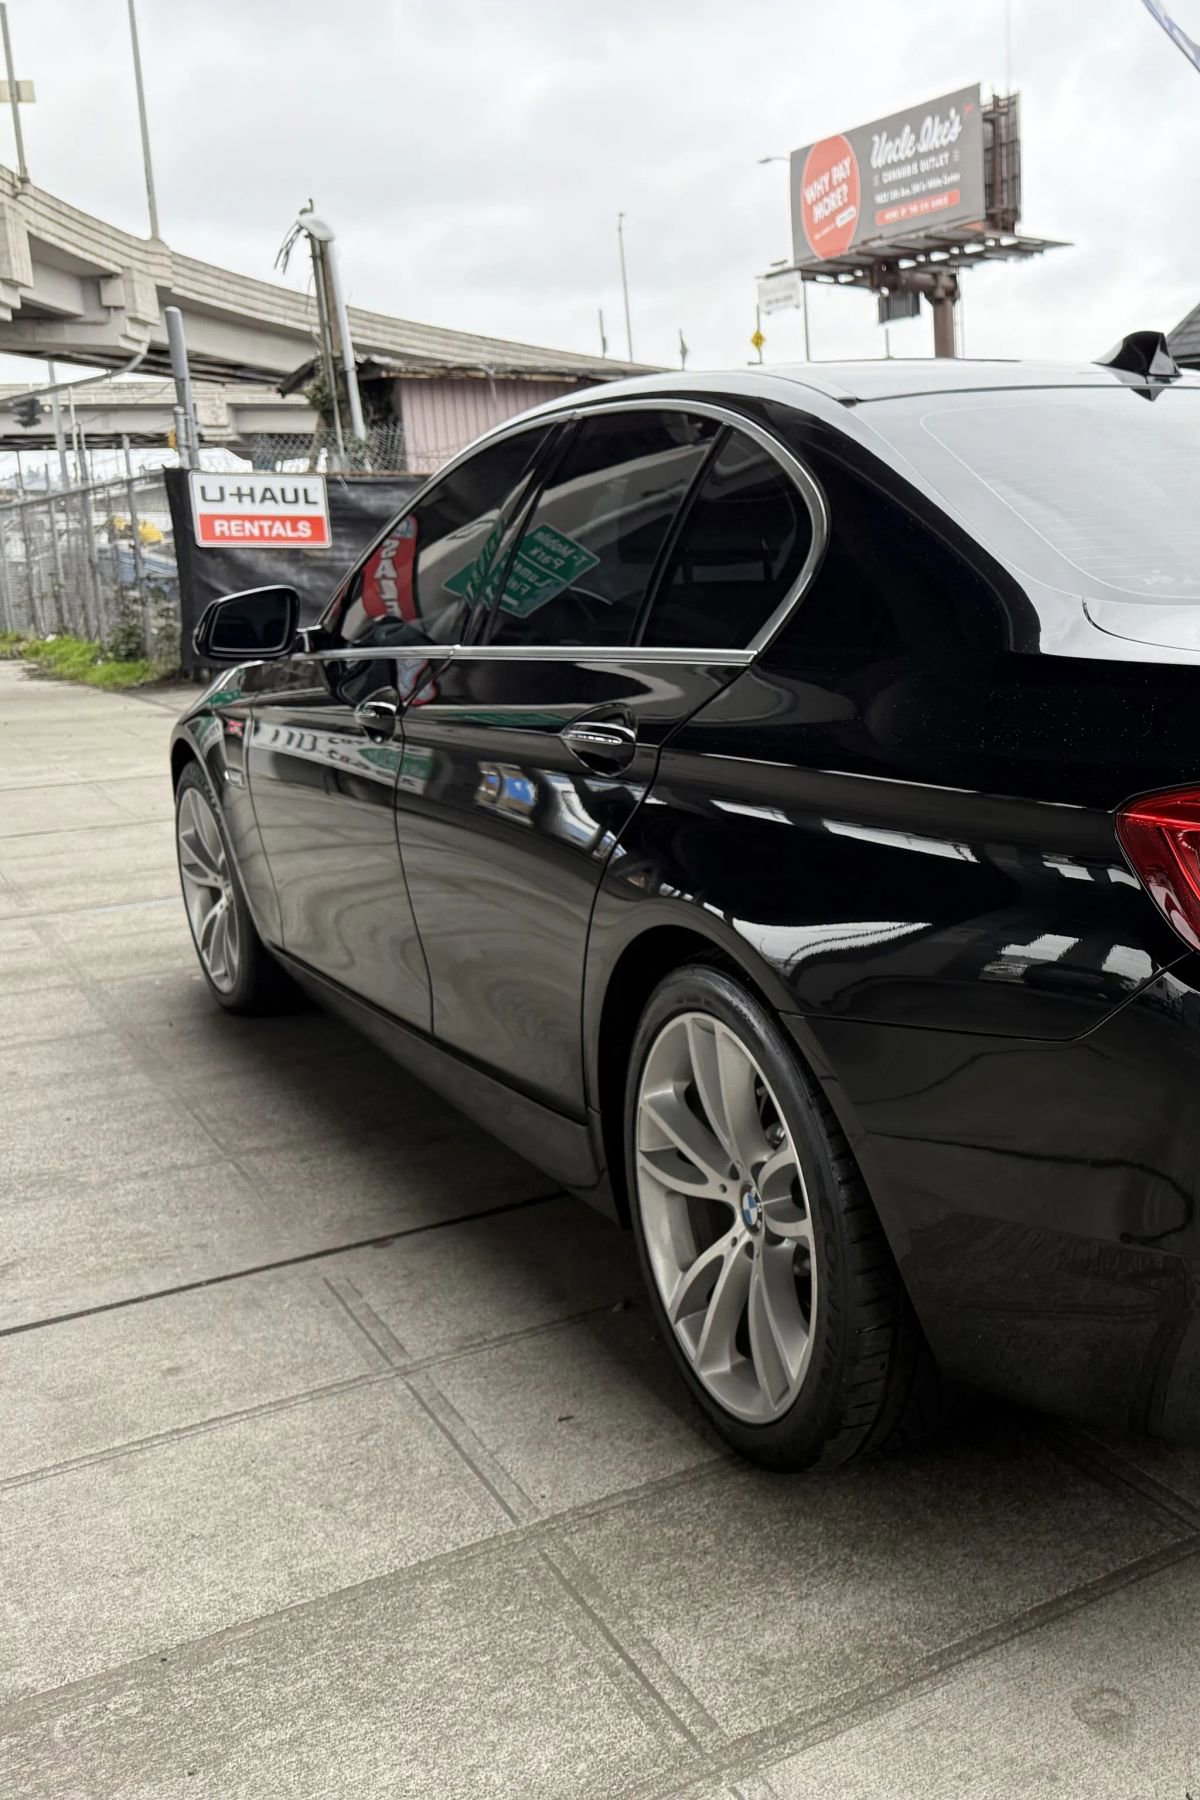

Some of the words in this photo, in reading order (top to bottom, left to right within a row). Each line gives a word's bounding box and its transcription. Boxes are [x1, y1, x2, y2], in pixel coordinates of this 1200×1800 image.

[870, 124, 916, 168] Uncle
[919, 151, 949, 172] OUTLET
[805, 171, 830, 205] WHY
[831, 156, 851, 186] PAY
[813, 182, 849, 224] MORE?
[200, 485, 319, 505] U-HAUL
[214, 519, 312, 538] RENTALS
